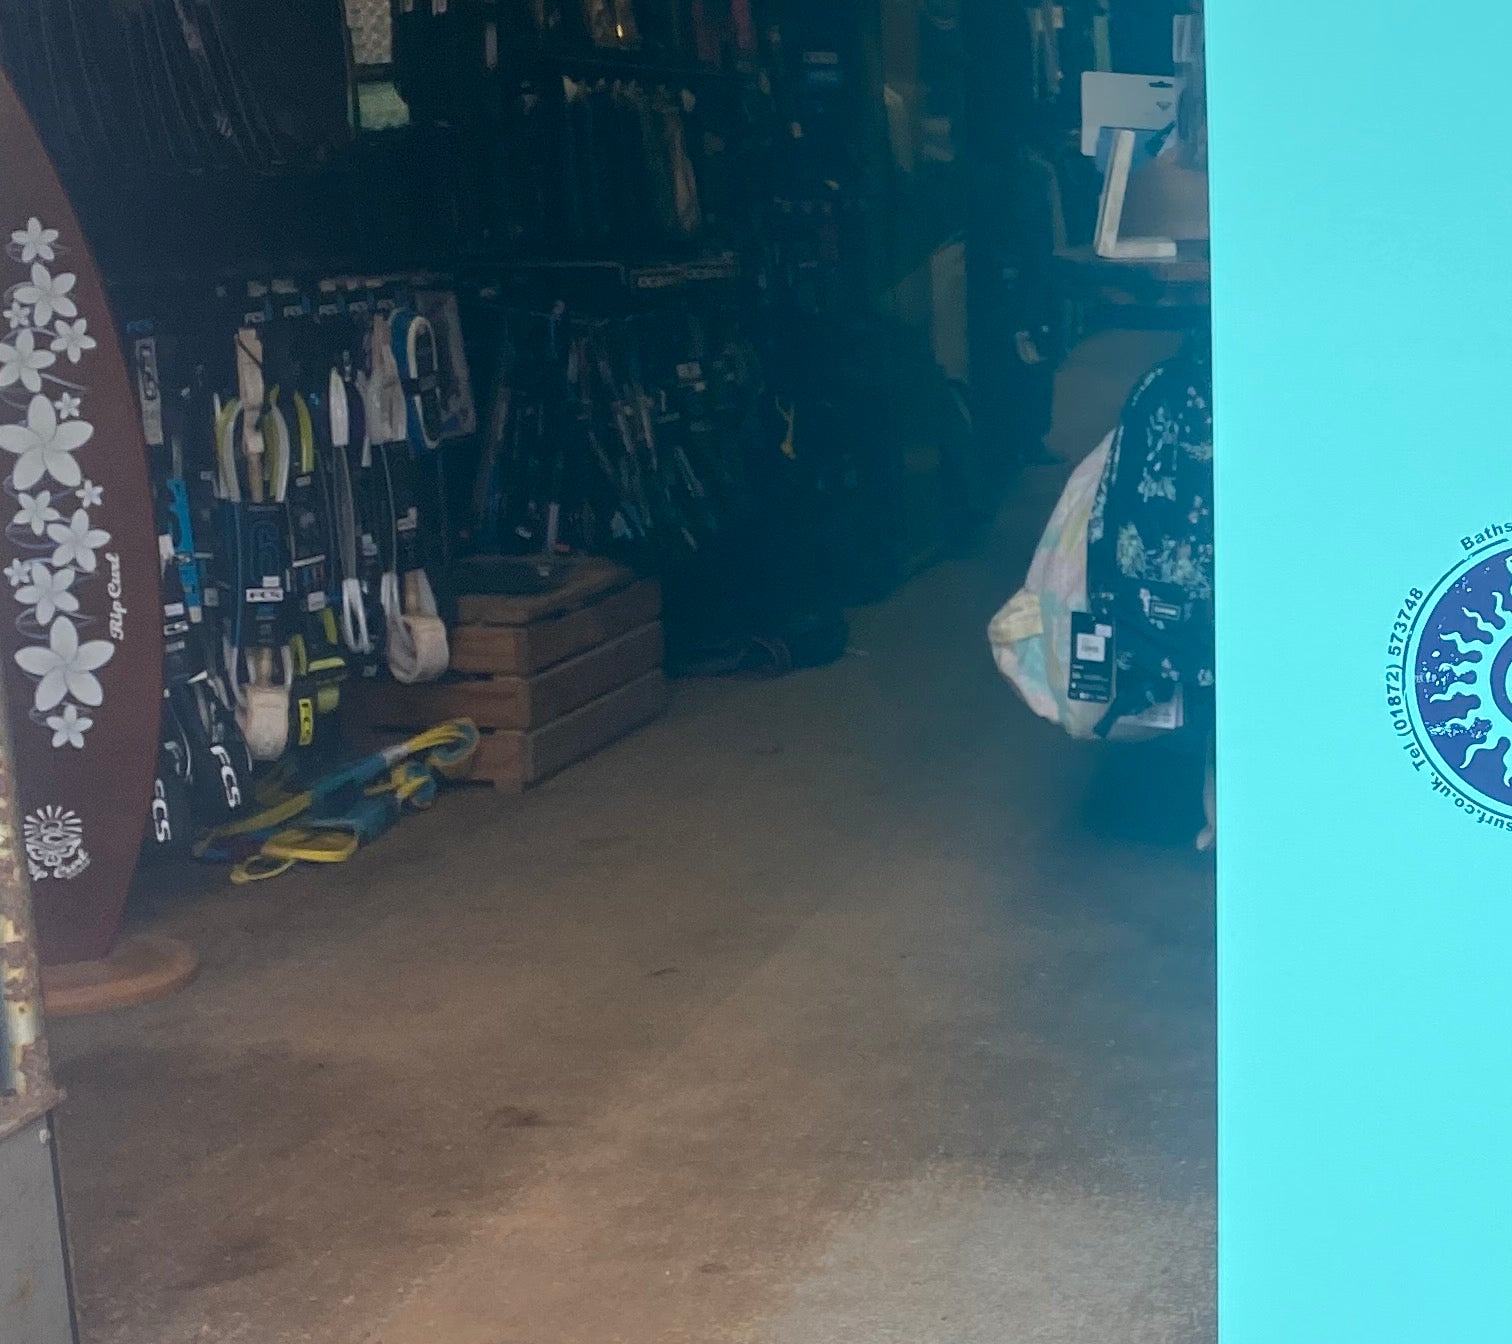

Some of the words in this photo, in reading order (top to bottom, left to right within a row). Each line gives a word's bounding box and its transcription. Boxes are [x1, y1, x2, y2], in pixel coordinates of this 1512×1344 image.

[1387, 587, 1424, 657] 573748
[1385, 664, 1414, 737] (01872)
[209, 744, 242, 808] FCS
[1402, 742, 1427, 773] Tel
